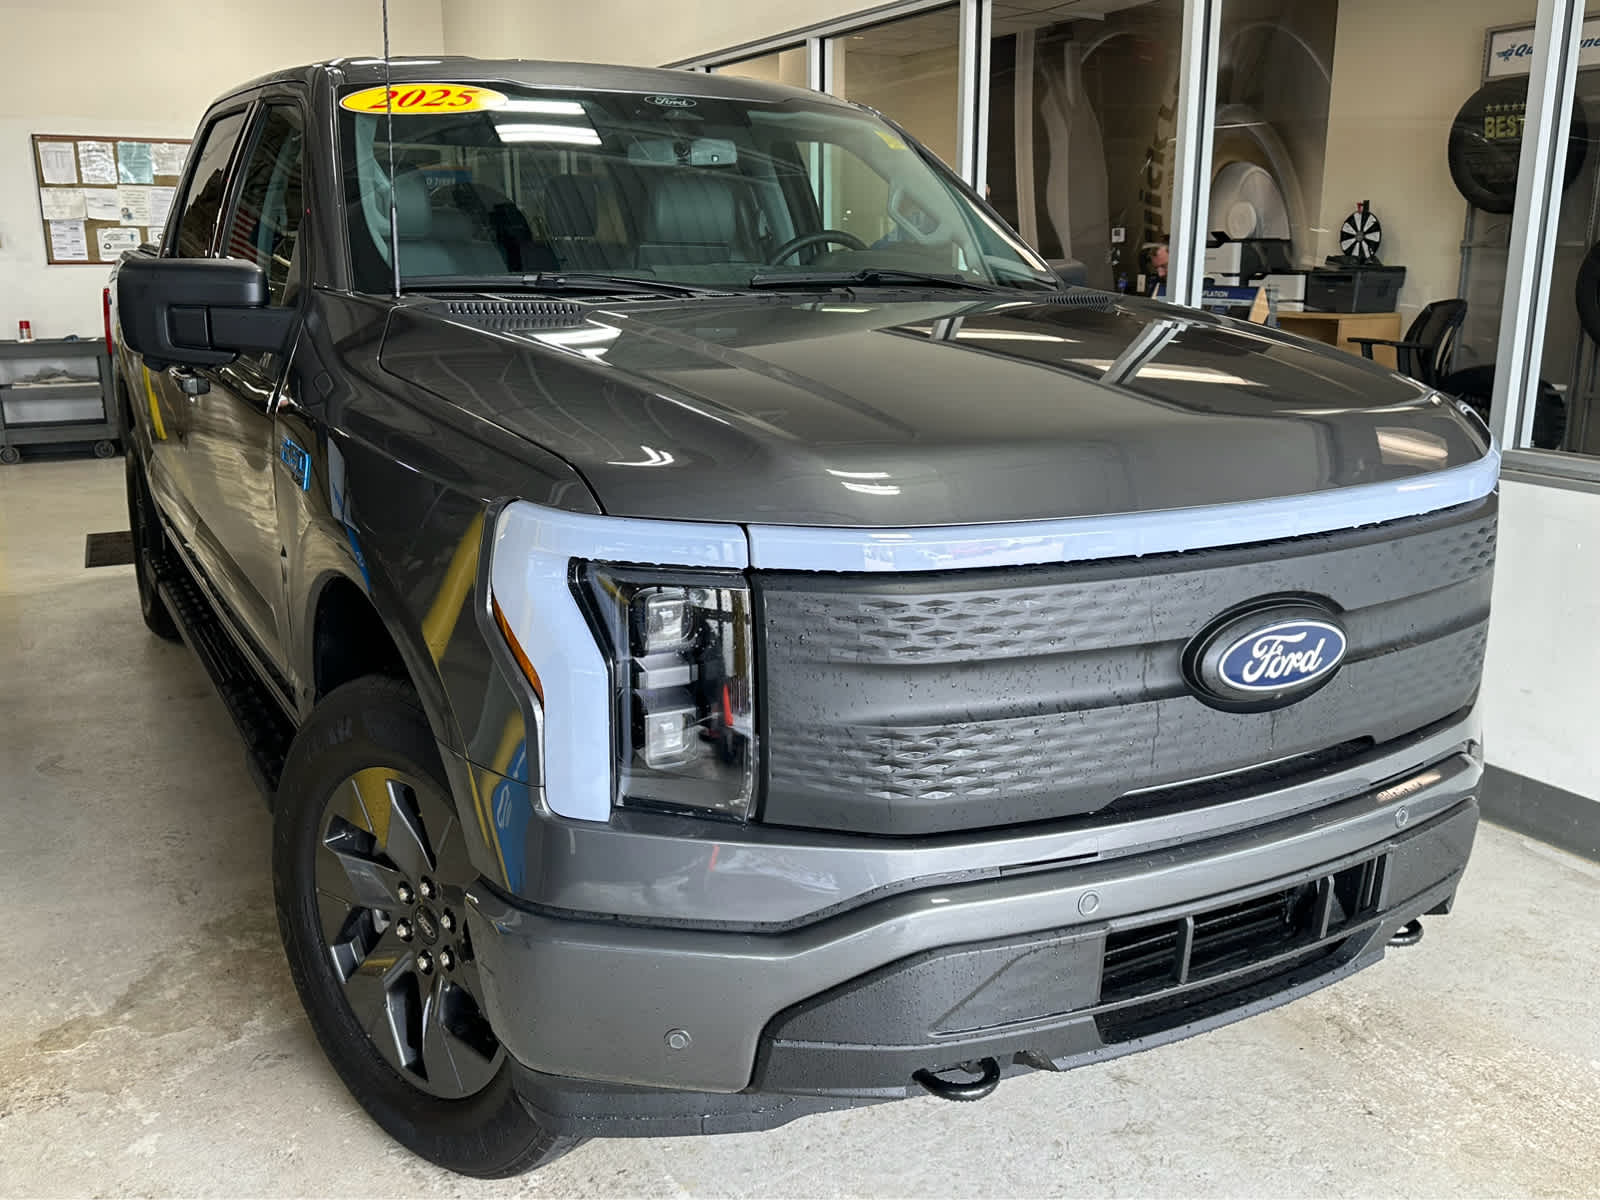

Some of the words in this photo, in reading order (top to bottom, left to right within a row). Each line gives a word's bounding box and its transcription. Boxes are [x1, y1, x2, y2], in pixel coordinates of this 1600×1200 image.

[368, 88, 481, 109] 2025
[655, 95, 689, 106] Ford
[1484, 115, 1526, 138] BEST
[1242, 631, 1326, 683] Ford
